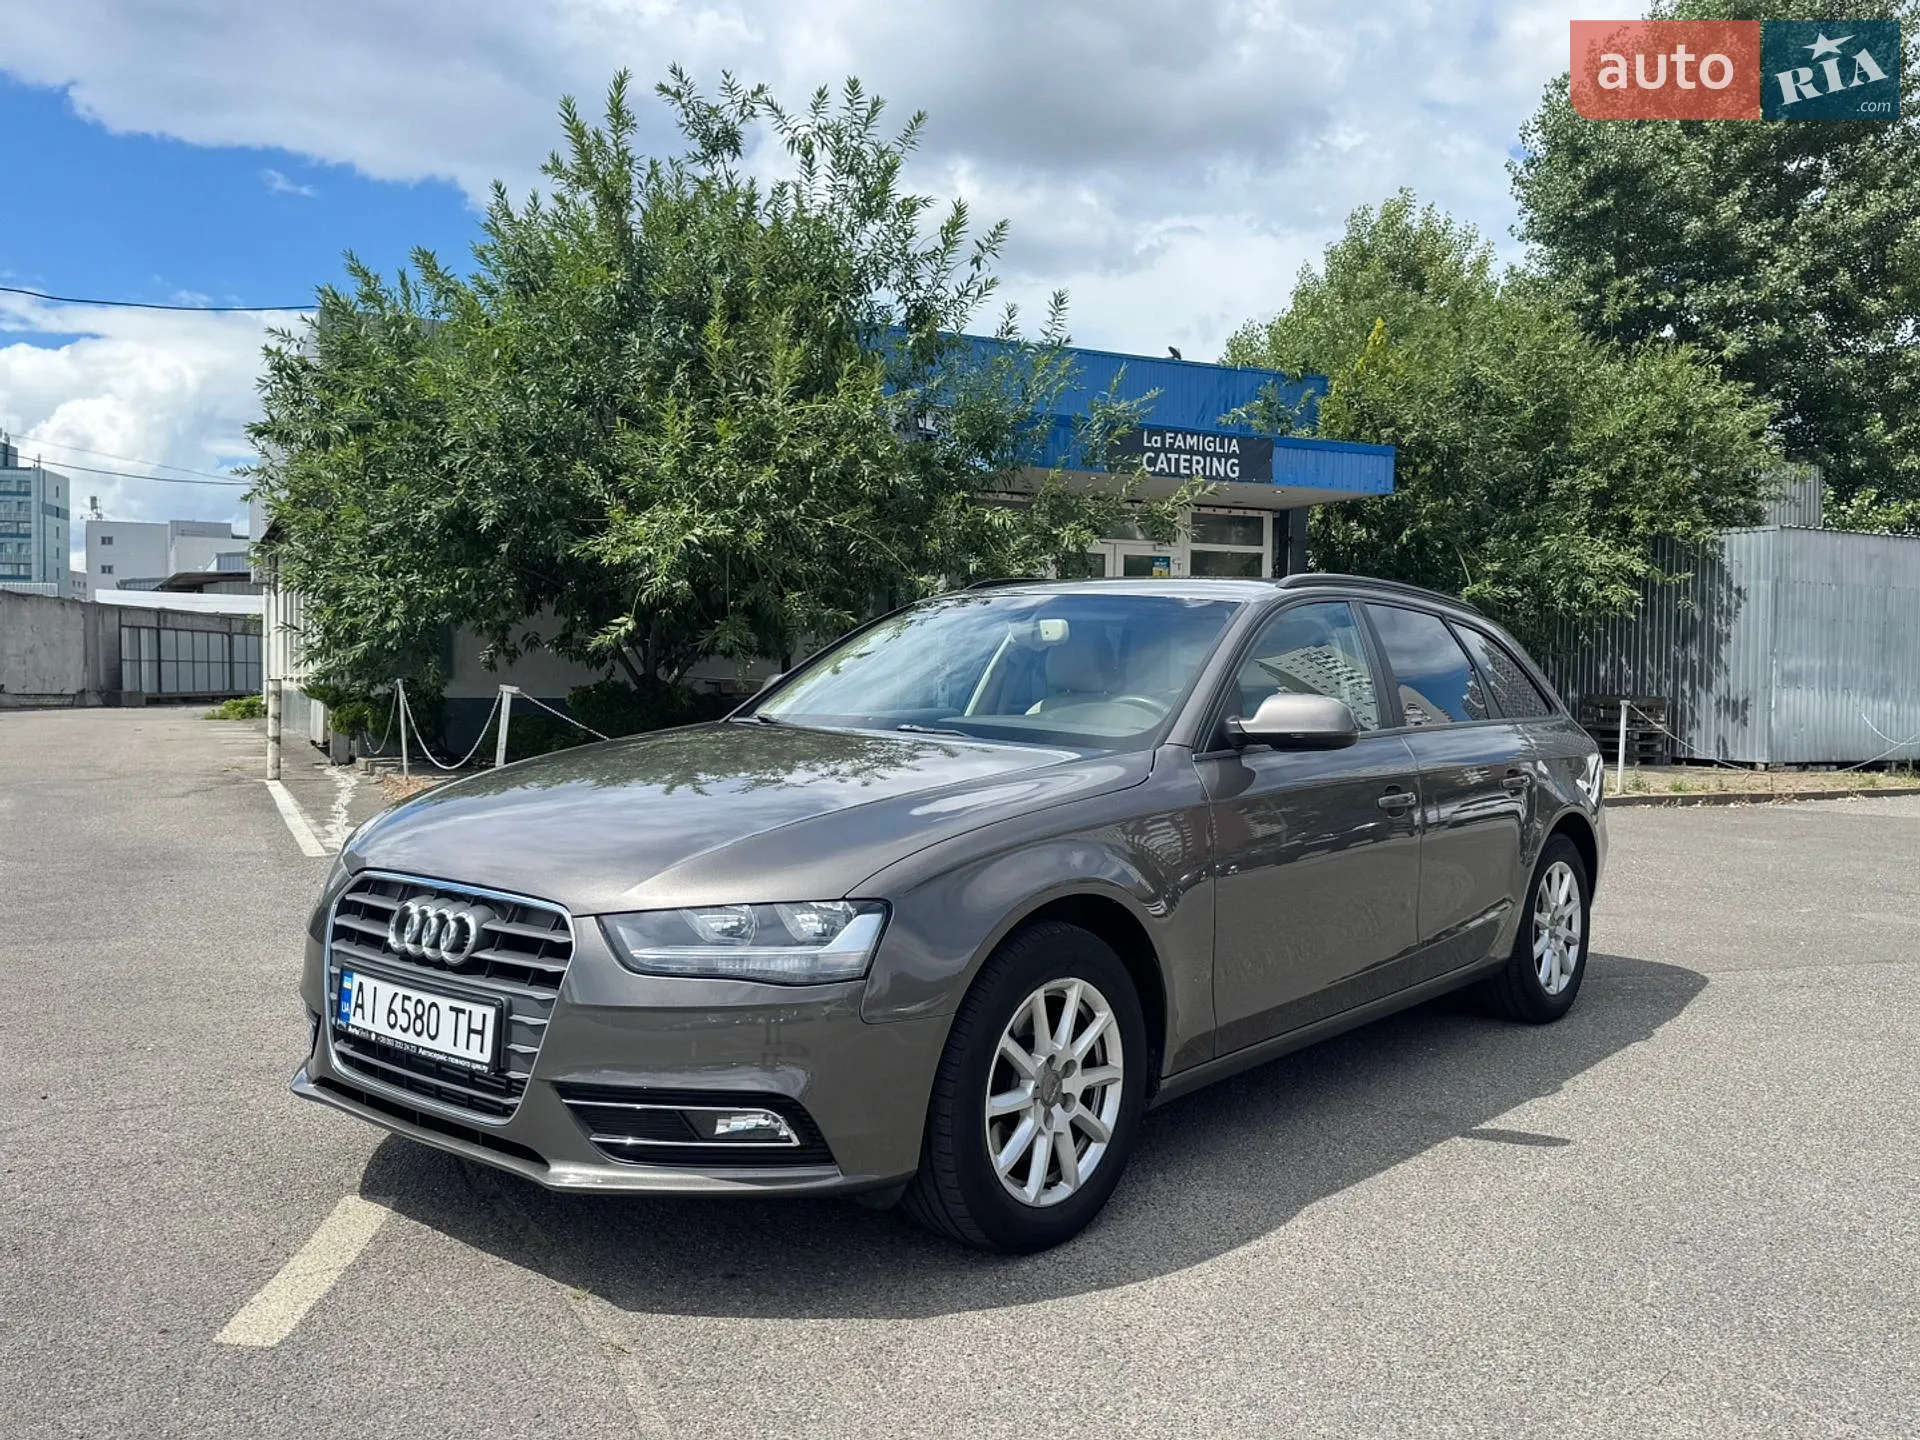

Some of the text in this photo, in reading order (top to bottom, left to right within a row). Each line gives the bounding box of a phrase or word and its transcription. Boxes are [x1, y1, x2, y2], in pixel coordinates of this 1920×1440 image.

[1143, 431, 1240, 455] La FAMIGLIA
[1142, 452, 1240, 478] CATERING
[353, 981, 487, 1054] AI 6580 TH
